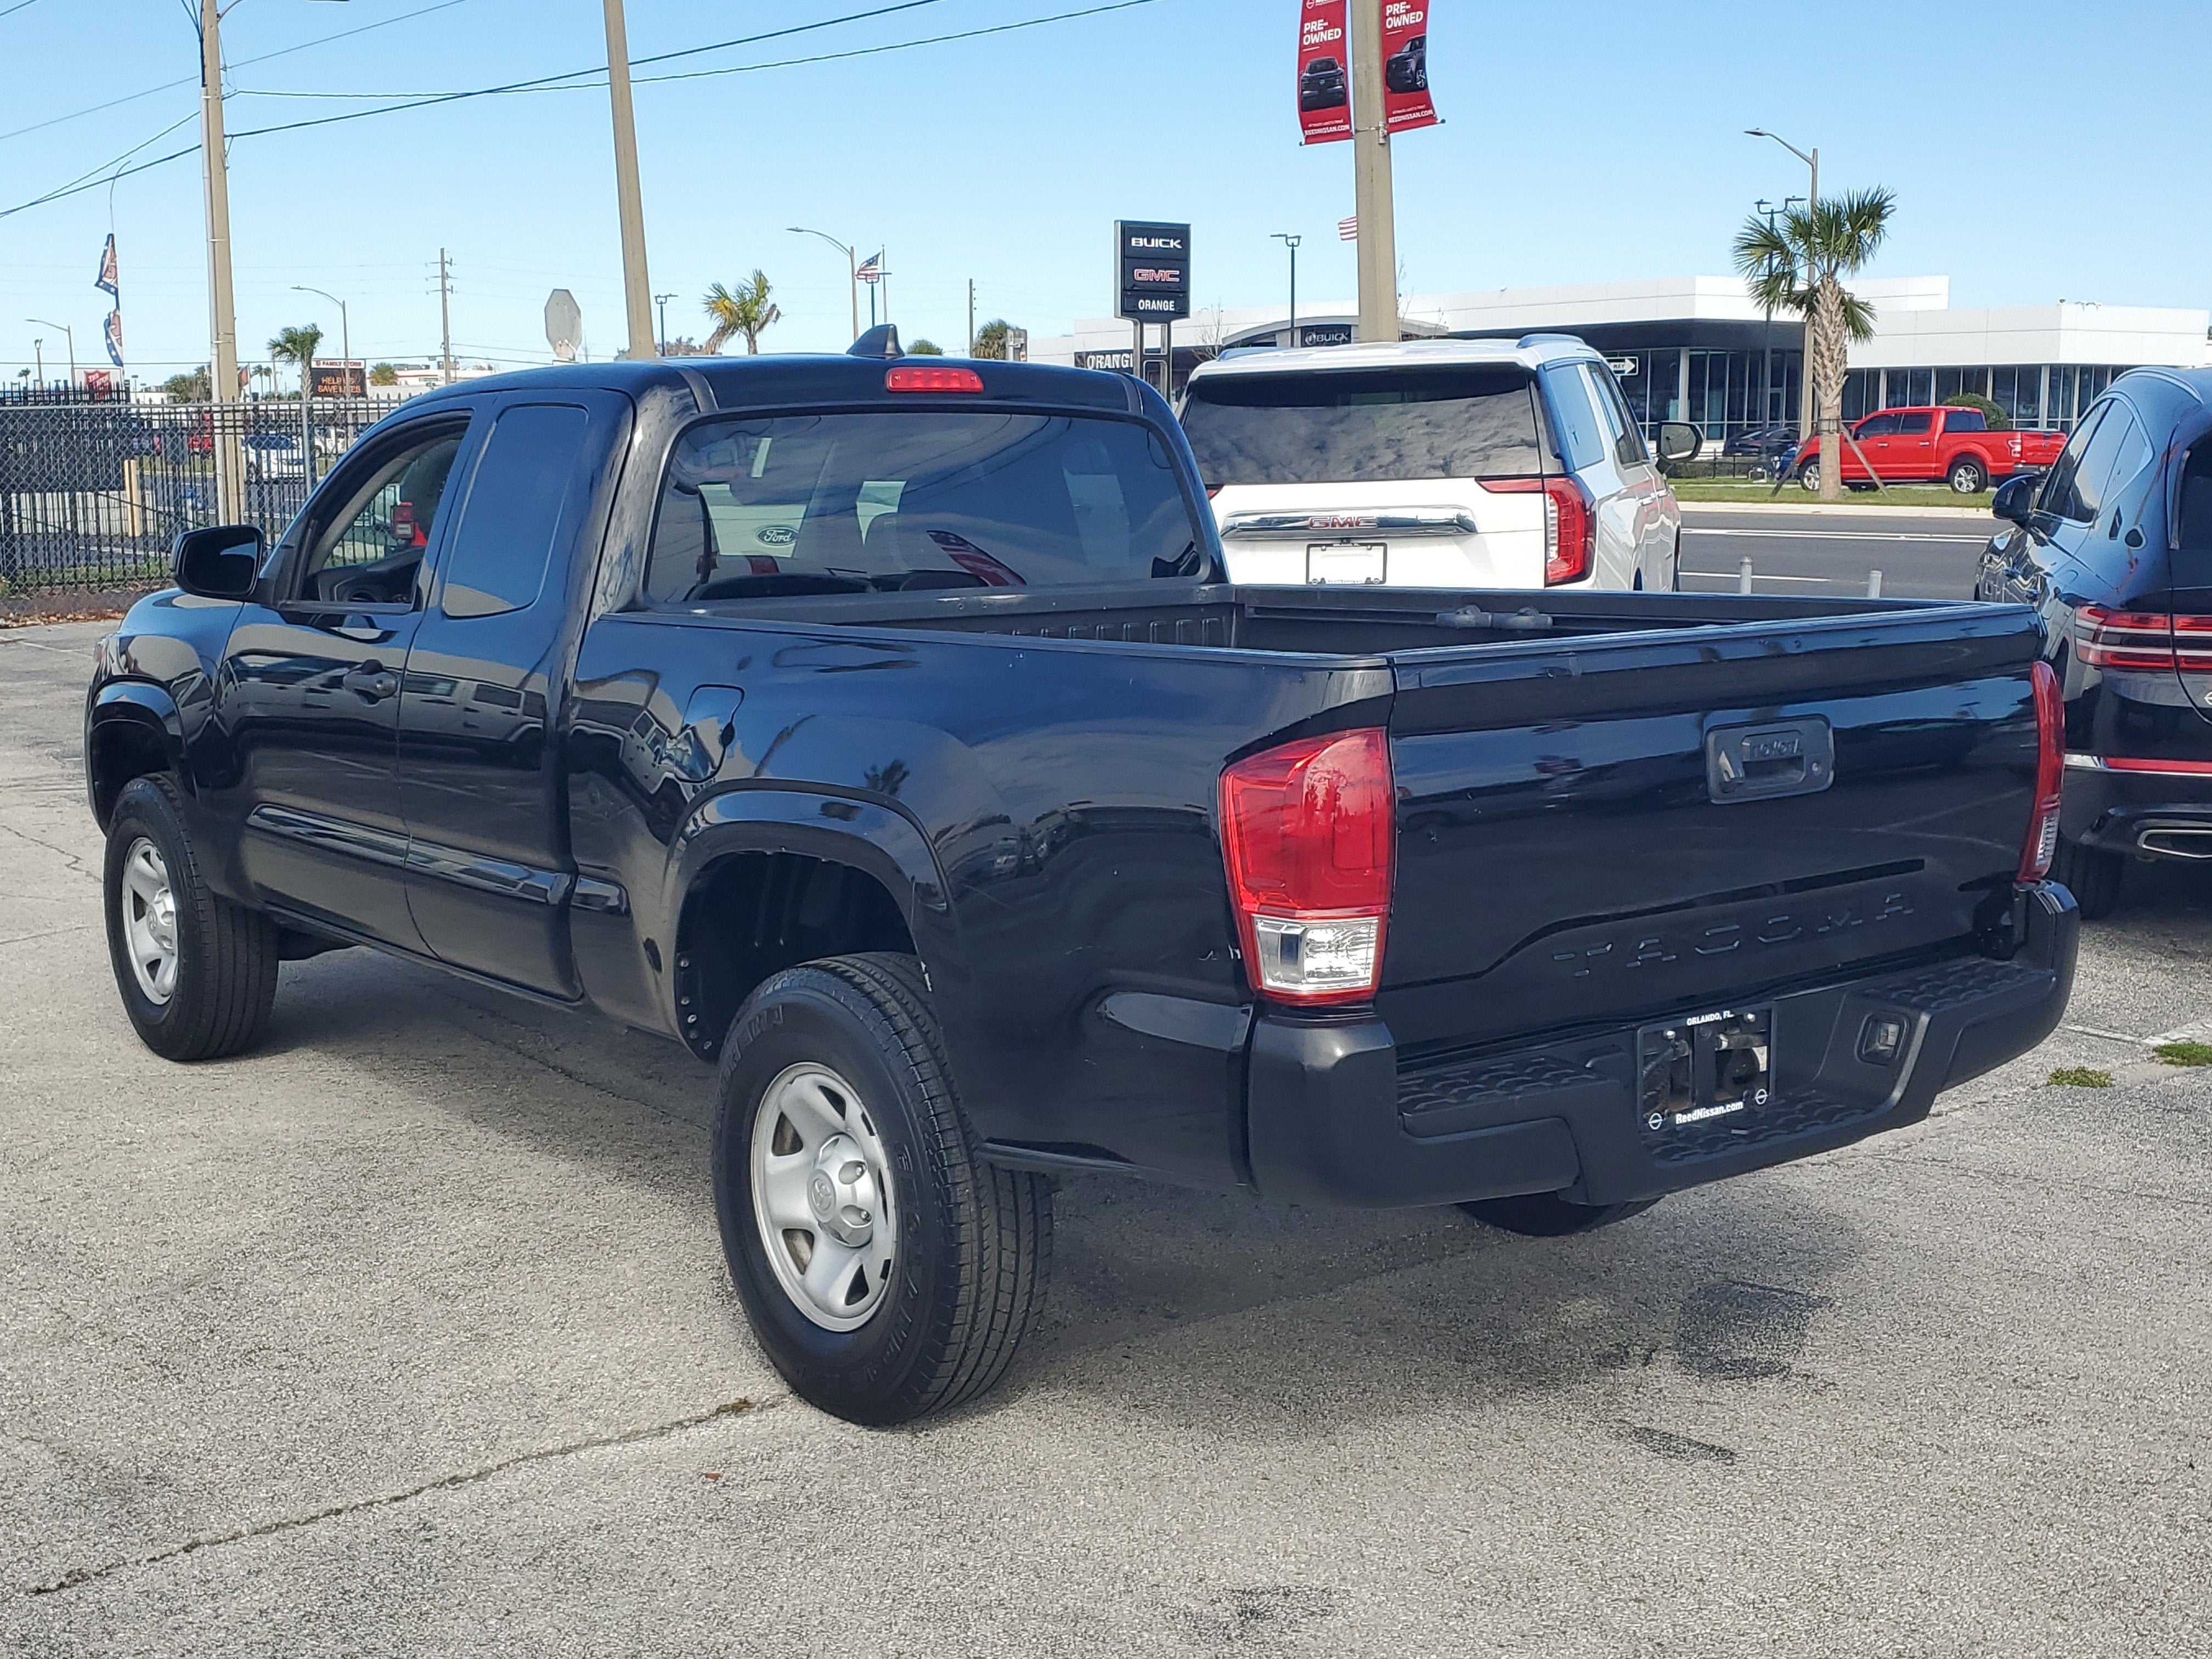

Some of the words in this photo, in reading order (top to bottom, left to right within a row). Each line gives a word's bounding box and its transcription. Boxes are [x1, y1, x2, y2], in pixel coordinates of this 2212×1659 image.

[1386, 1, 1411, 16] PRE-
[1304, 19, 1328, 33] PRE-
[1386, 10, 1424, 29] OWNED
[1303, 28, 1342, 46] OWNED
[1131, 236, 1182, 249] BUICK
[1134, 268, 1180, 282] GMC
[1138, 299, 1175, 312] ORANGE
[1317, 332, 1348, 342] BUICK
[321, 376, 342, 384] HELP
[318, 385, 338, 393] SAVE
[1309, 516, 1378, 529] GMC
[764, 529, 792, 542] Ford
[1550, 891, 1915, 977] TACOMA
[1686, 1012, 1722, 1026] ORLANDO,
[1675, 1101, 1743, 1124] ReedNissan.com
